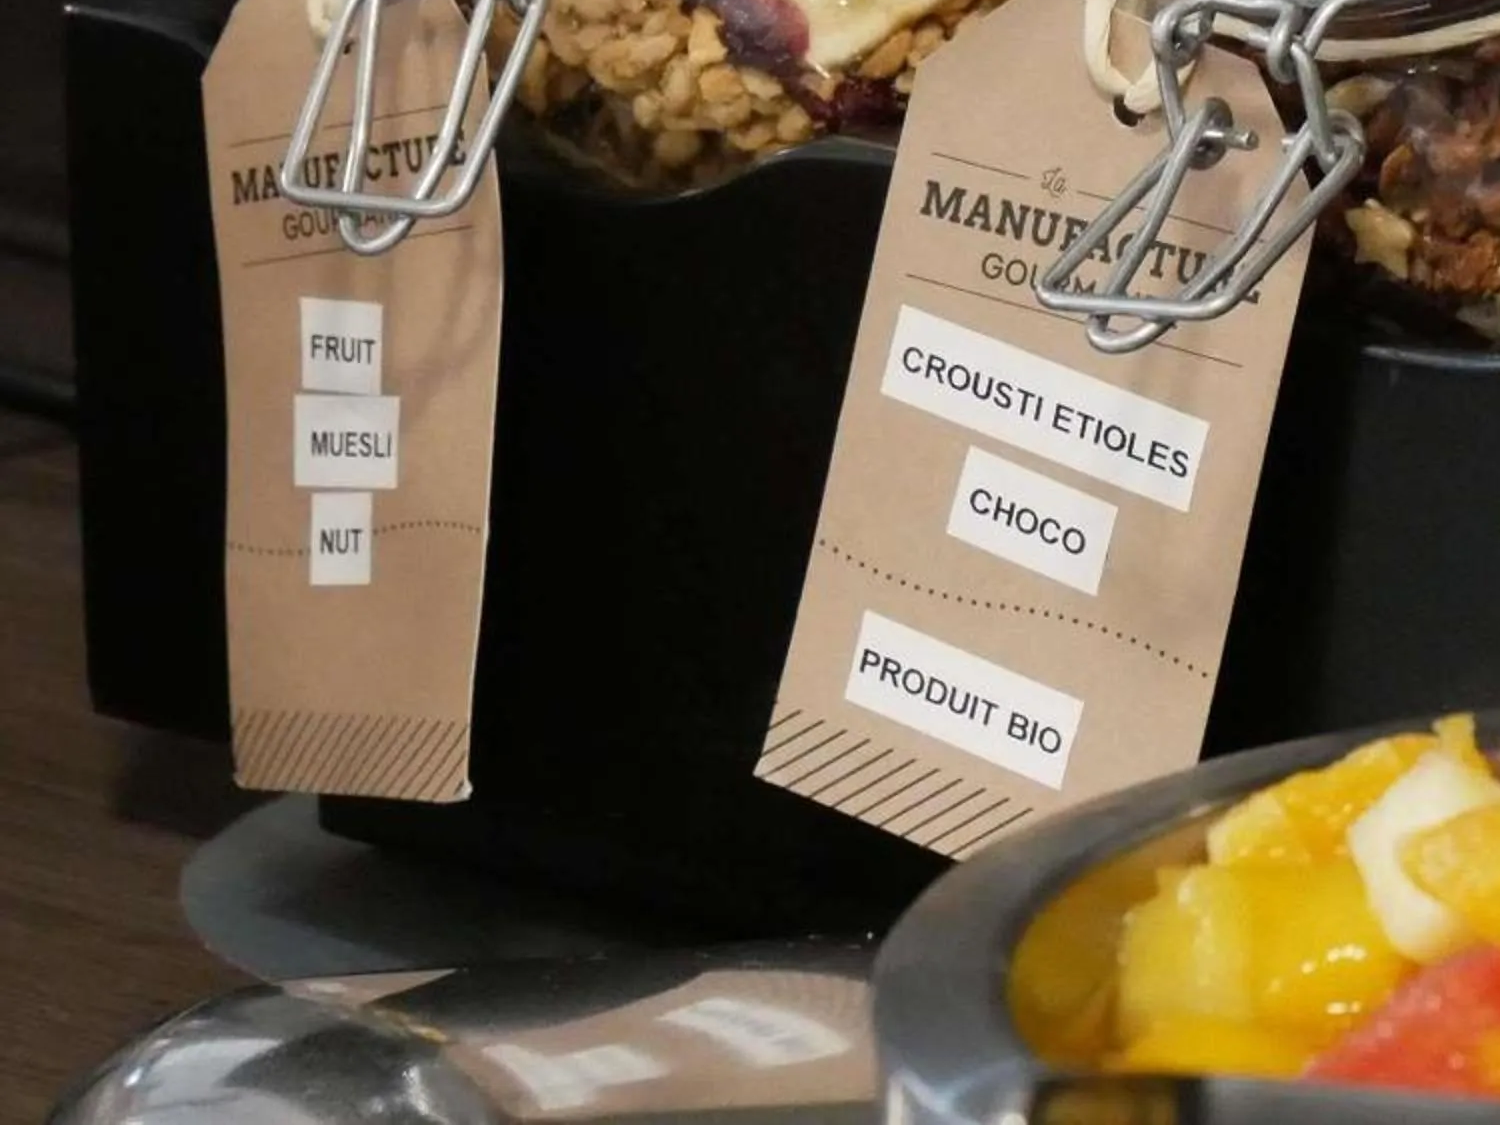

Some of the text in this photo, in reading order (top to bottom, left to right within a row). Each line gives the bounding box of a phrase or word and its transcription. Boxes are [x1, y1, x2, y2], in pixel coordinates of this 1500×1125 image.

[232, 127, 466, 205] MAUFCTUE
[310, 334, 375, 365] FRUIT
[311, 430, 392, 459] MUESLI
[902, 345, 1190, 478] CROUSTI ETIOLES
[319, 528, 363, 556] NUT
[969, 487, 1087, 556] CHOCO
[859, 647, 1063, 756] PRODUIT BIO
